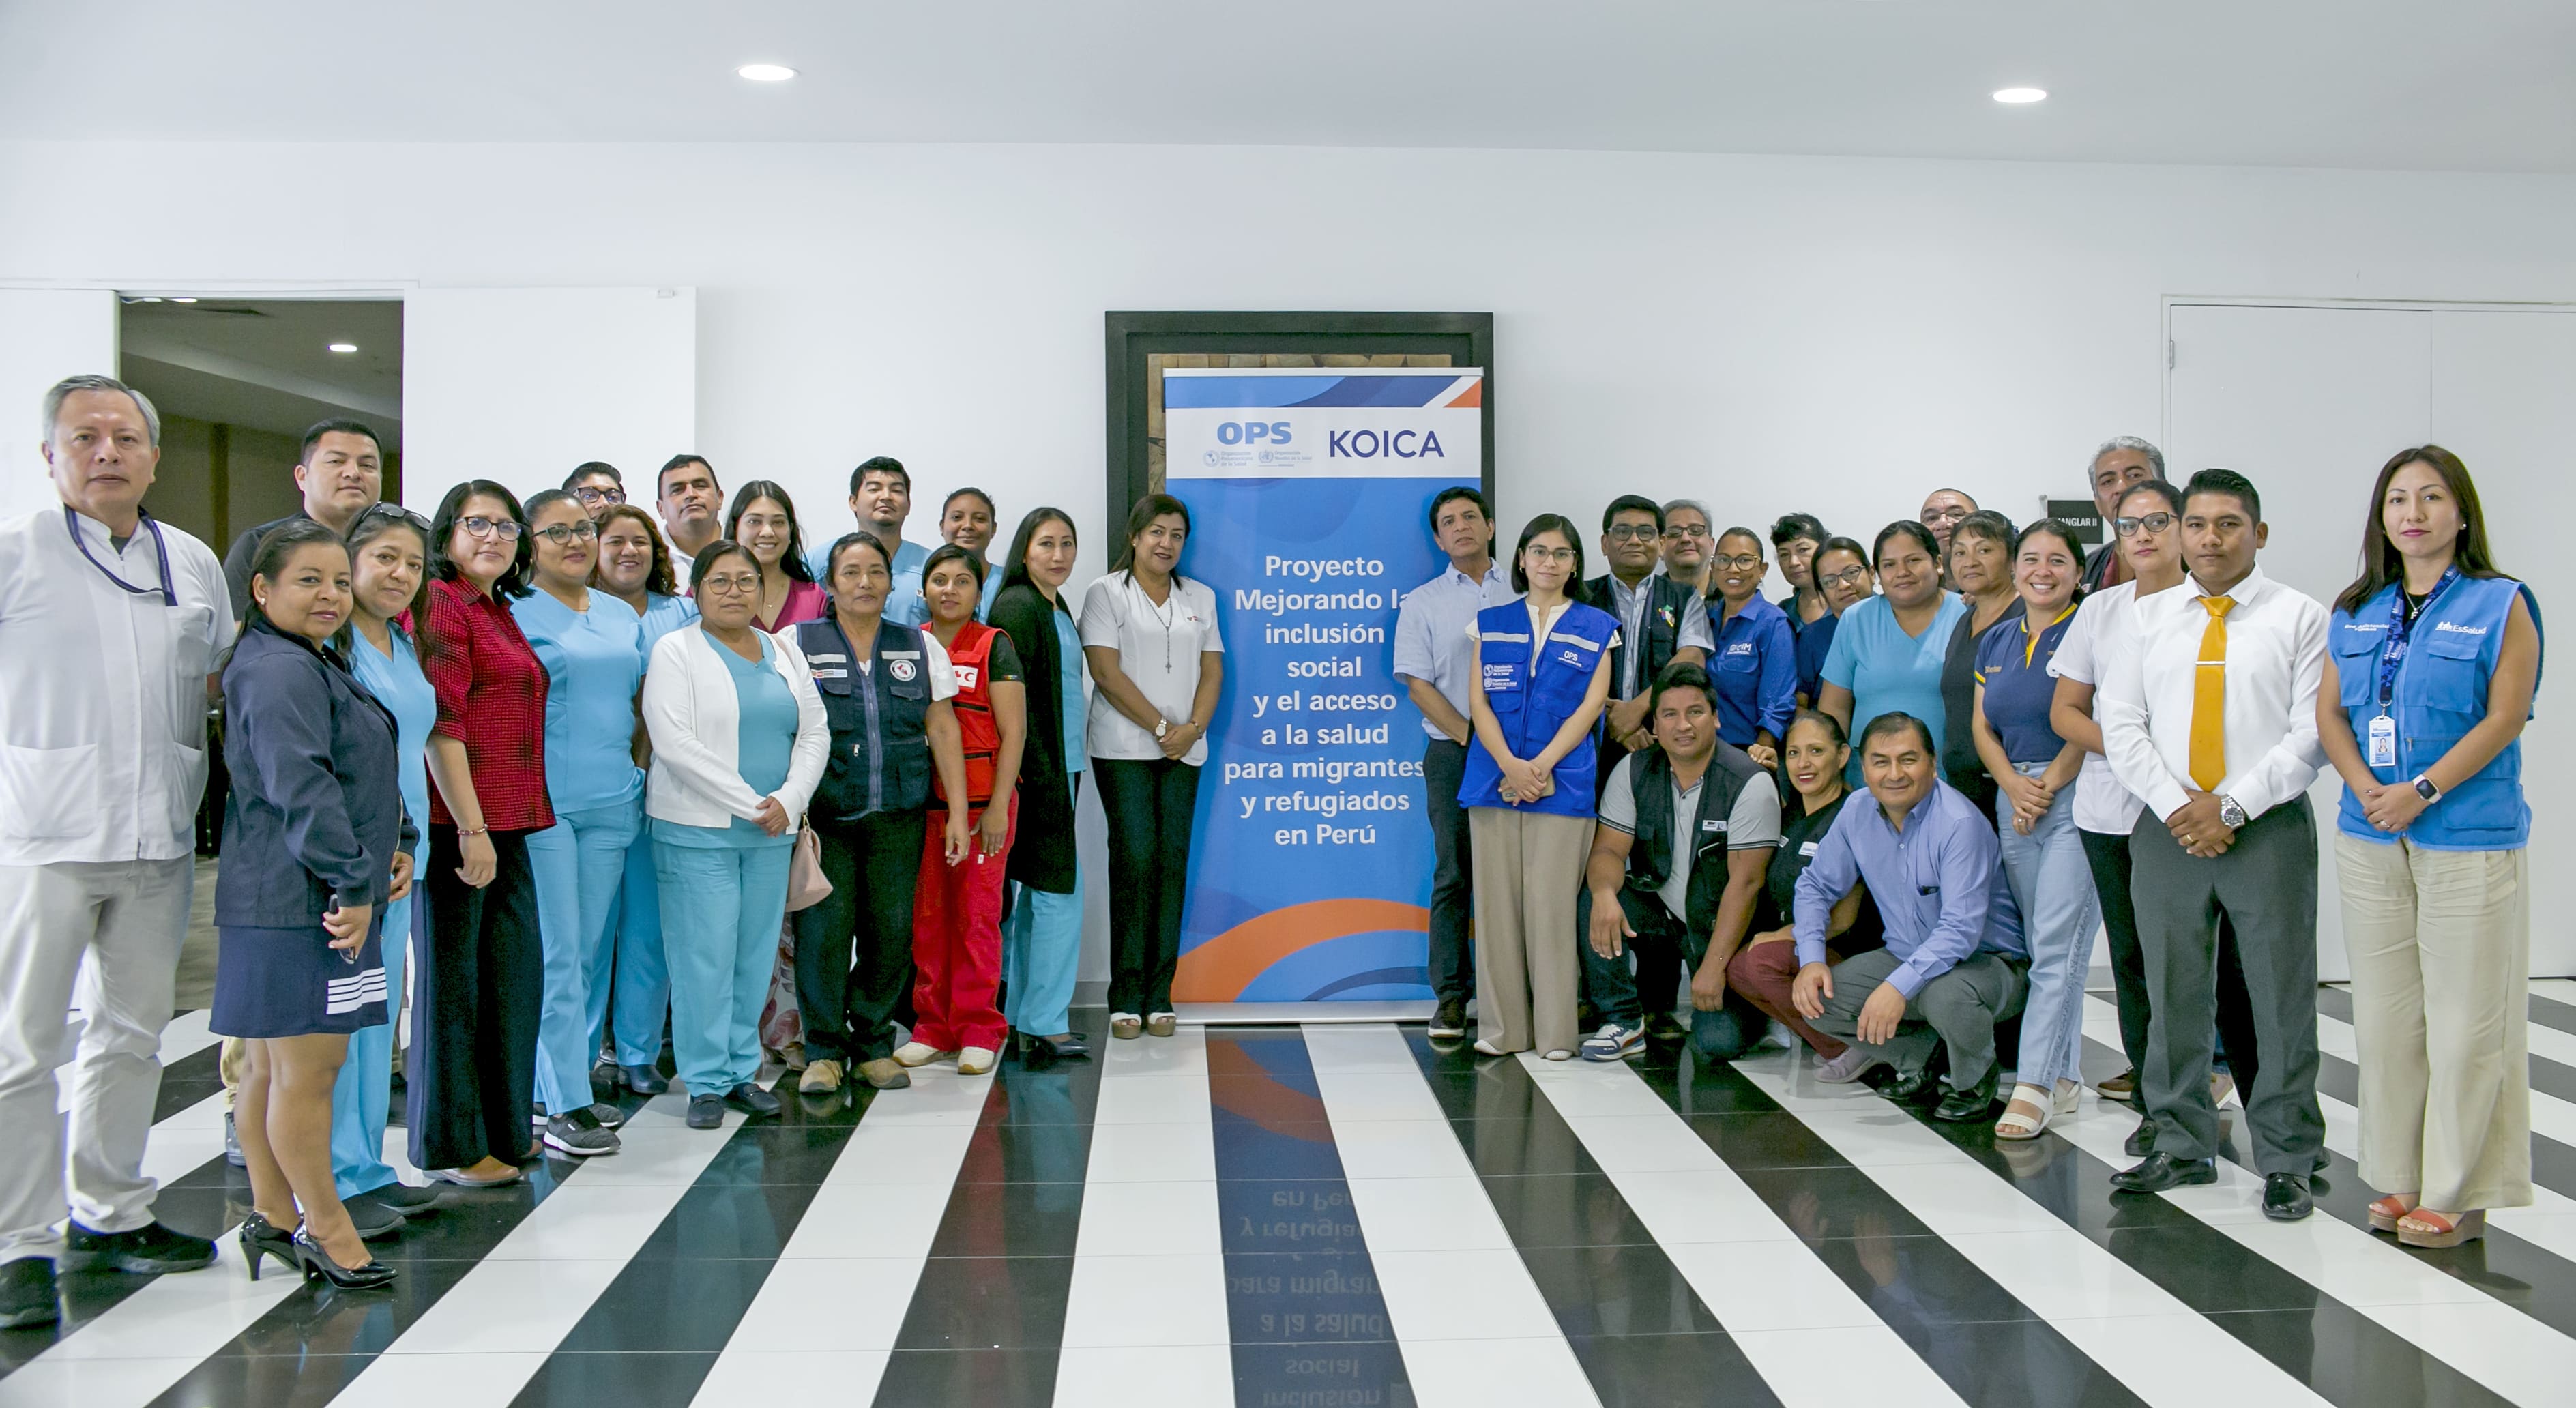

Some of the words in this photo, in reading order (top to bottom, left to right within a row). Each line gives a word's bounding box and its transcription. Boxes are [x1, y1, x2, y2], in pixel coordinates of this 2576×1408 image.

[1217, 422, 1292, 445] OPS
[1330, 430, 1445, 458] KOICA
[2058, 518, 2091, 526] ANGLAR
[2092, 518, 2097, 526] II
[1265, 555, 1384, 583] Proyecto
[1235, 589, 1383, 616] Mejorando
[1265, 623, 1384, 643] inclusión
[2453, 624, 2487, 634] EsSalud
[1287, 656, 1362, 677] social
[1564, 650, 1579, 662] OPS
[1253, 694, 1269, 718] y
[1276, 690, 1300, 711] el
[1309, 694, 1396, 711] acceso
[1261, 729, 1276, 745] a
[1286, 724, 1308, 744] la
[1317, 723, 1388, 744] salud
[1225, 762, 1283, 784] para
[1293, 757, 1424, 784] migrantes
[1240, 796, 1257, 819] y
[1265, 790, 1410, 817] refugiados
[1274, 828, 1308, 845] en
[1317, 824, 1376, 845] Perú
